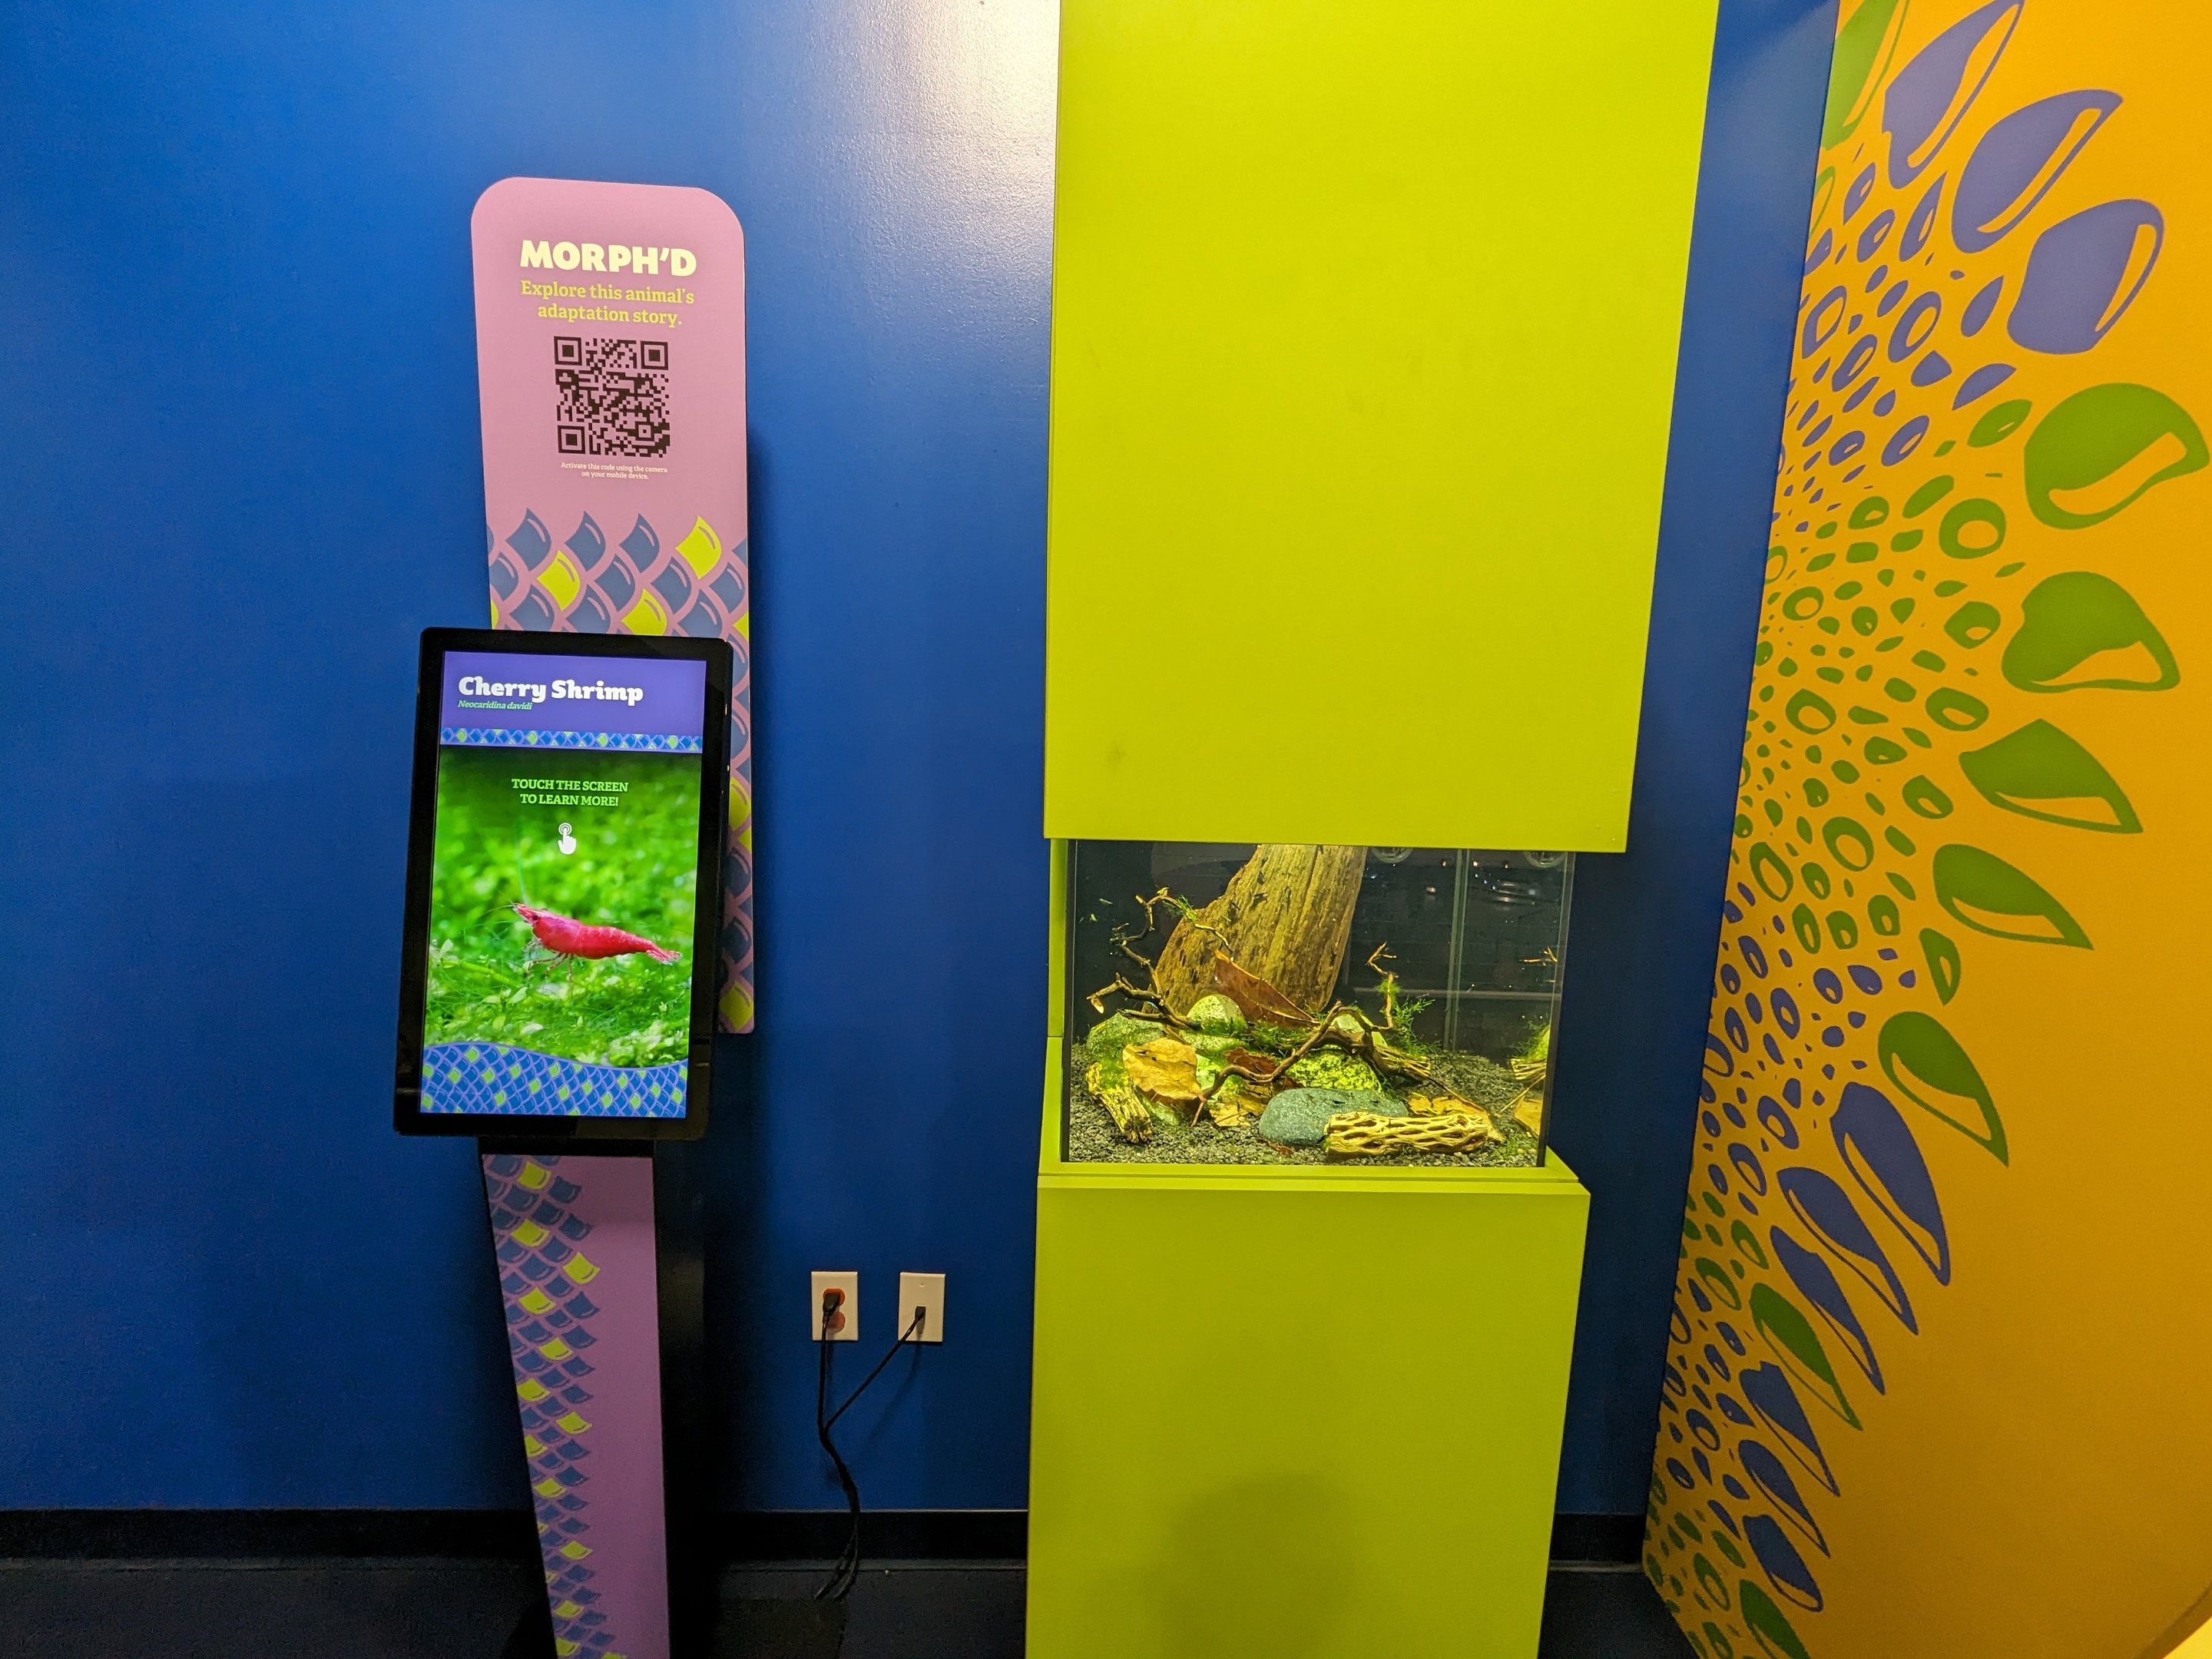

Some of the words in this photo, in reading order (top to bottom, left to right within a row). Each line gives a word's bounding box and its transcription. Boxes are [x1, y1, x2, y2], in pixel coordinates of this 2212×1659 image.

[520, 240, 697, 276] MORPH'D
[521, 280, 586, 300] Explore
[589, 283, 622, 300] this
[626, 286, 694, 304] animal's
[538, 303, 630, 323] adaptation
[633, 309, 682, 328] story.
[459, 676, 546, 703] Cherry
[551, 679, 644, 707] Shrimp
[458, 700, 506, 709] Neocaridina
[507, 701, 533, 710] davidi
[512, 778, 555, 790] TOUCH
[556, 780, 581, 790] THE
[582, 781, 629, 792] SCREEN
[520, 793, 537, 803] TO
[538, 794, 579, 805] LEARN
[581, 796, 619, 806] MORE!
